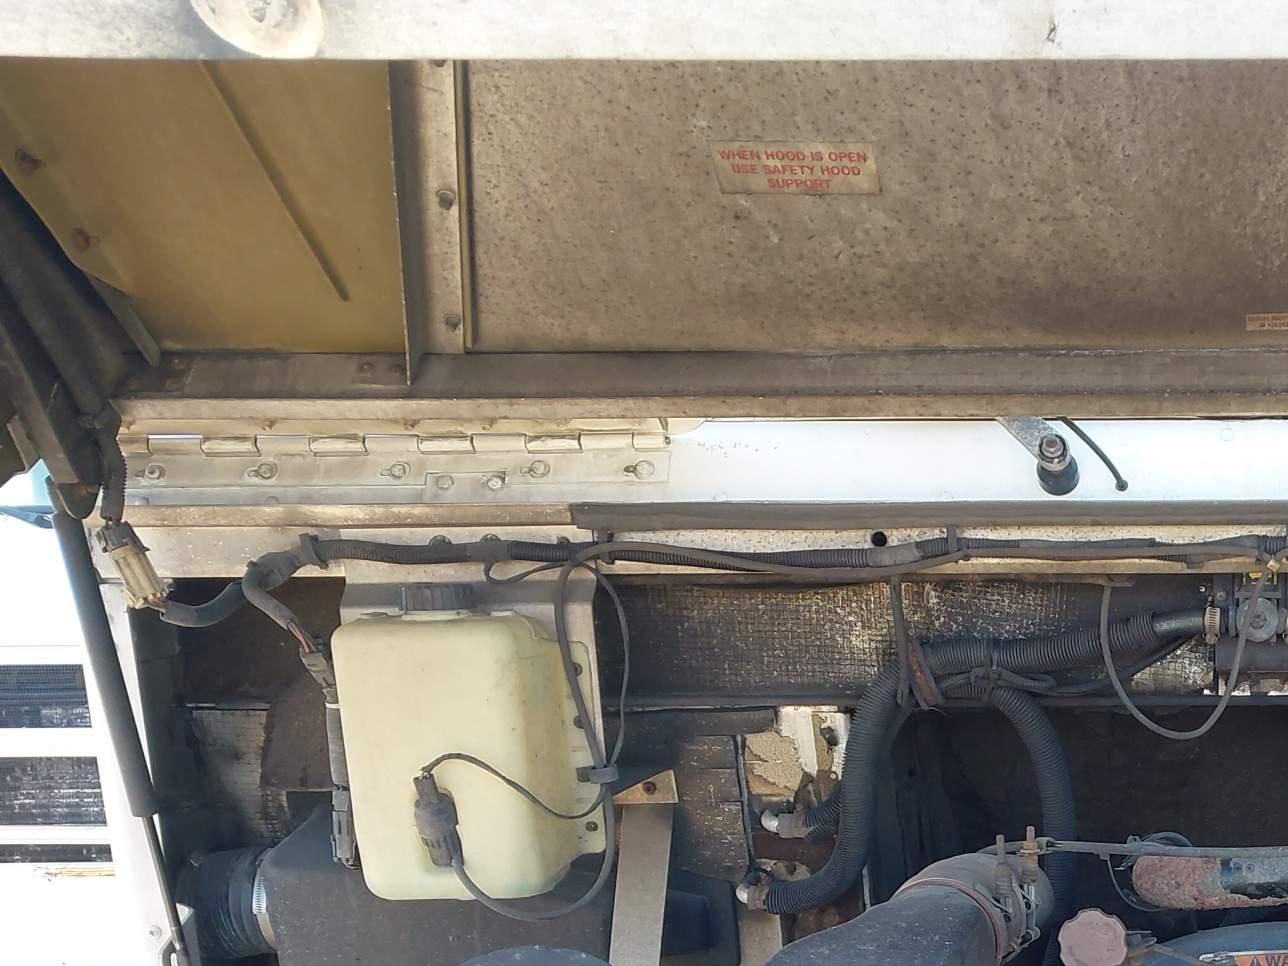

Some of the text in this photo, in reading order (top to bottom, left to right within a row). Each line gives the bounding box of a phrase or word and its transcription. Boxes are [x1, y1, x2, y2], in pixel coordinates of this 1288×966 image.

[720, 150, 868, 163] WHEN HOOD IS OPEN
[731, 164, 861, 176] USE SAFETY HOOD
[767, 178, 832, 189] SUPPORT
